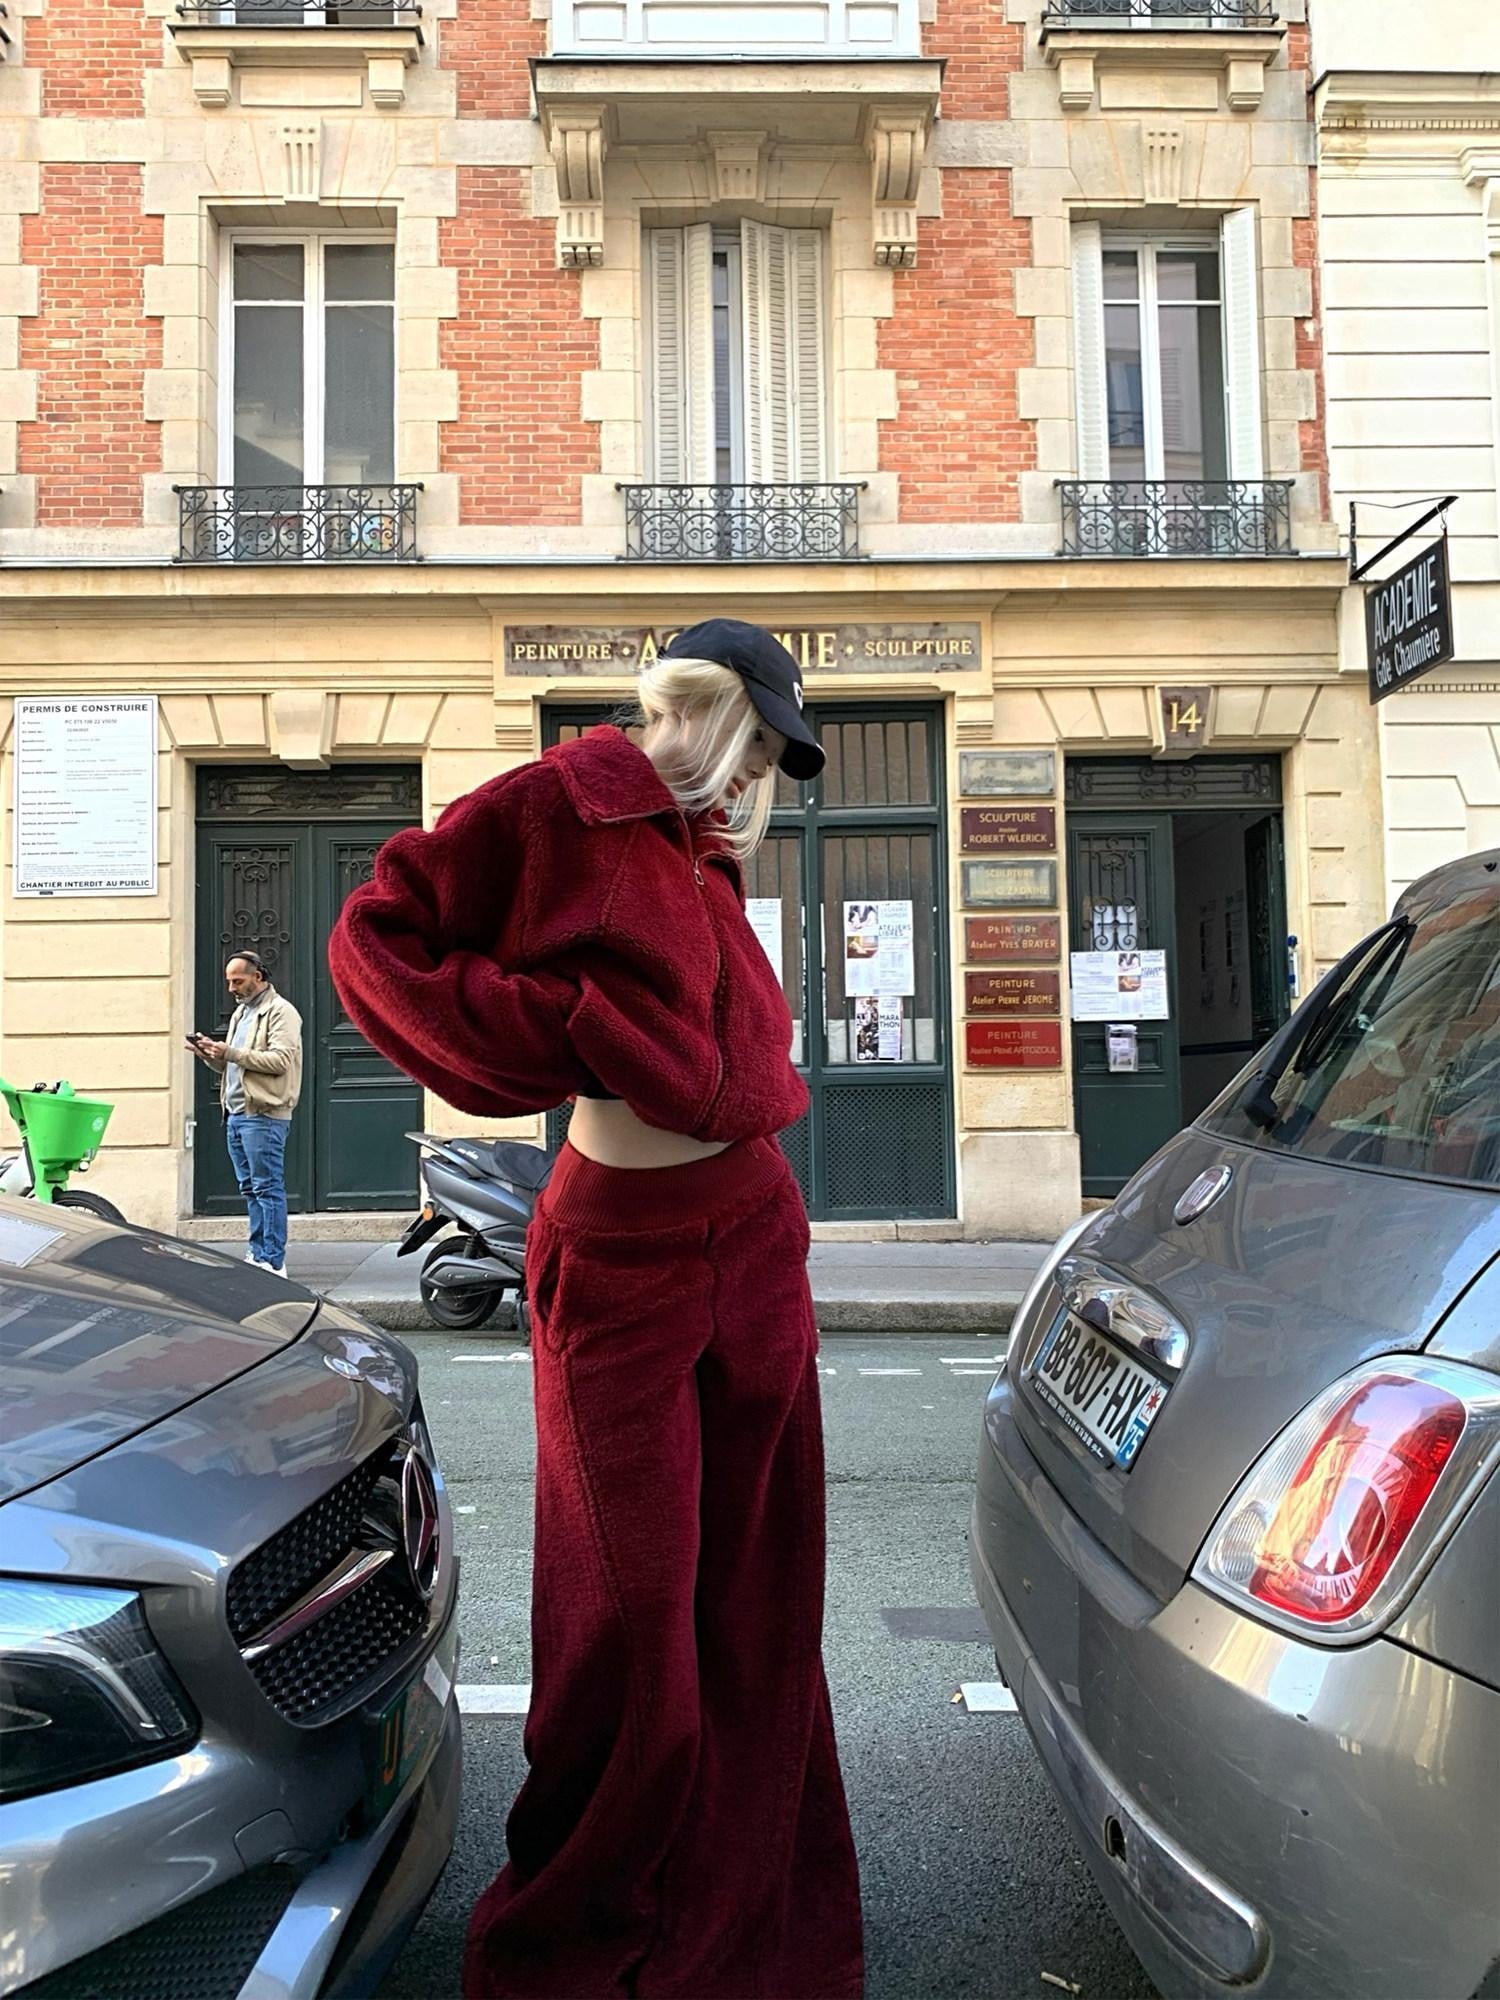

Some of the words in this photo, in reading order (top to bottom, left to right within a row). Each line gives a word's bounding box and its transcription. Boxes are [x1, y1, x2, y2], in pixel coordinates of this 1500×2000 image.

[1374, 555, 1438, 650] ACADEMIE
[514, 642, 611, 661] PEINTURE
[864, 637, 973, 656] SCULPTURE
[1375, 652, 1393, 689] Gde
[1394, 625, 1440, 678] Chaumière
[22, 705, 61, 714] PERMIS
[64, 705, 78, 713] DE
[81, 703, 148, 712] CONSTRUIRE
[1169, 701, 1202, 733] 14
[979, 812, 1037, 823] SCULPTURE
[969, 834, 1005, 844] ROBERT
[1007, 833, 1047, 843] WLERICK
[988, 979, 1036, 988] PEINTURE
[987, 1031, 1039, 1040] PEINTURE
[1042, 1319, 1151, 1446] BB-607-HX
[1118, 1423, 1145, 1460] 75
